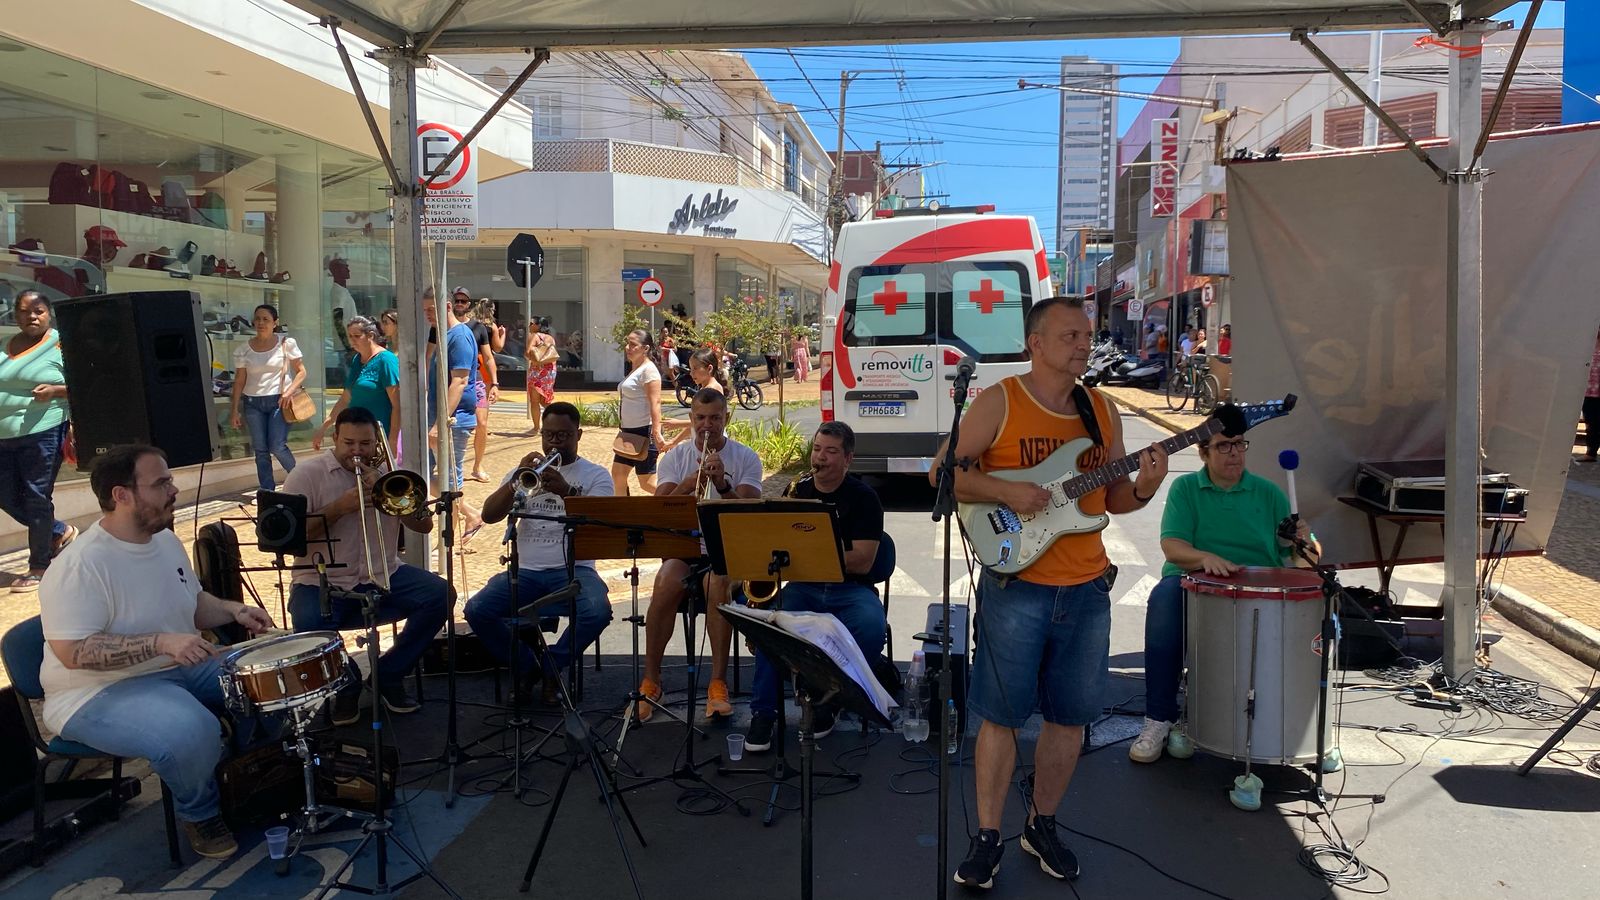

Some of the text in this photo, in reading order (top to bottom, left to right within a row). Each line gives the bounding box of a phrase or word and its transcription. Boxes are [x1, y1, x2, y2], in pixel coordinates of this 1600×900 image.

[423, 137, 450, 176] E
[861, 353, 933, 373] removitta
[862, 406, 901, 415] FPH6G83
